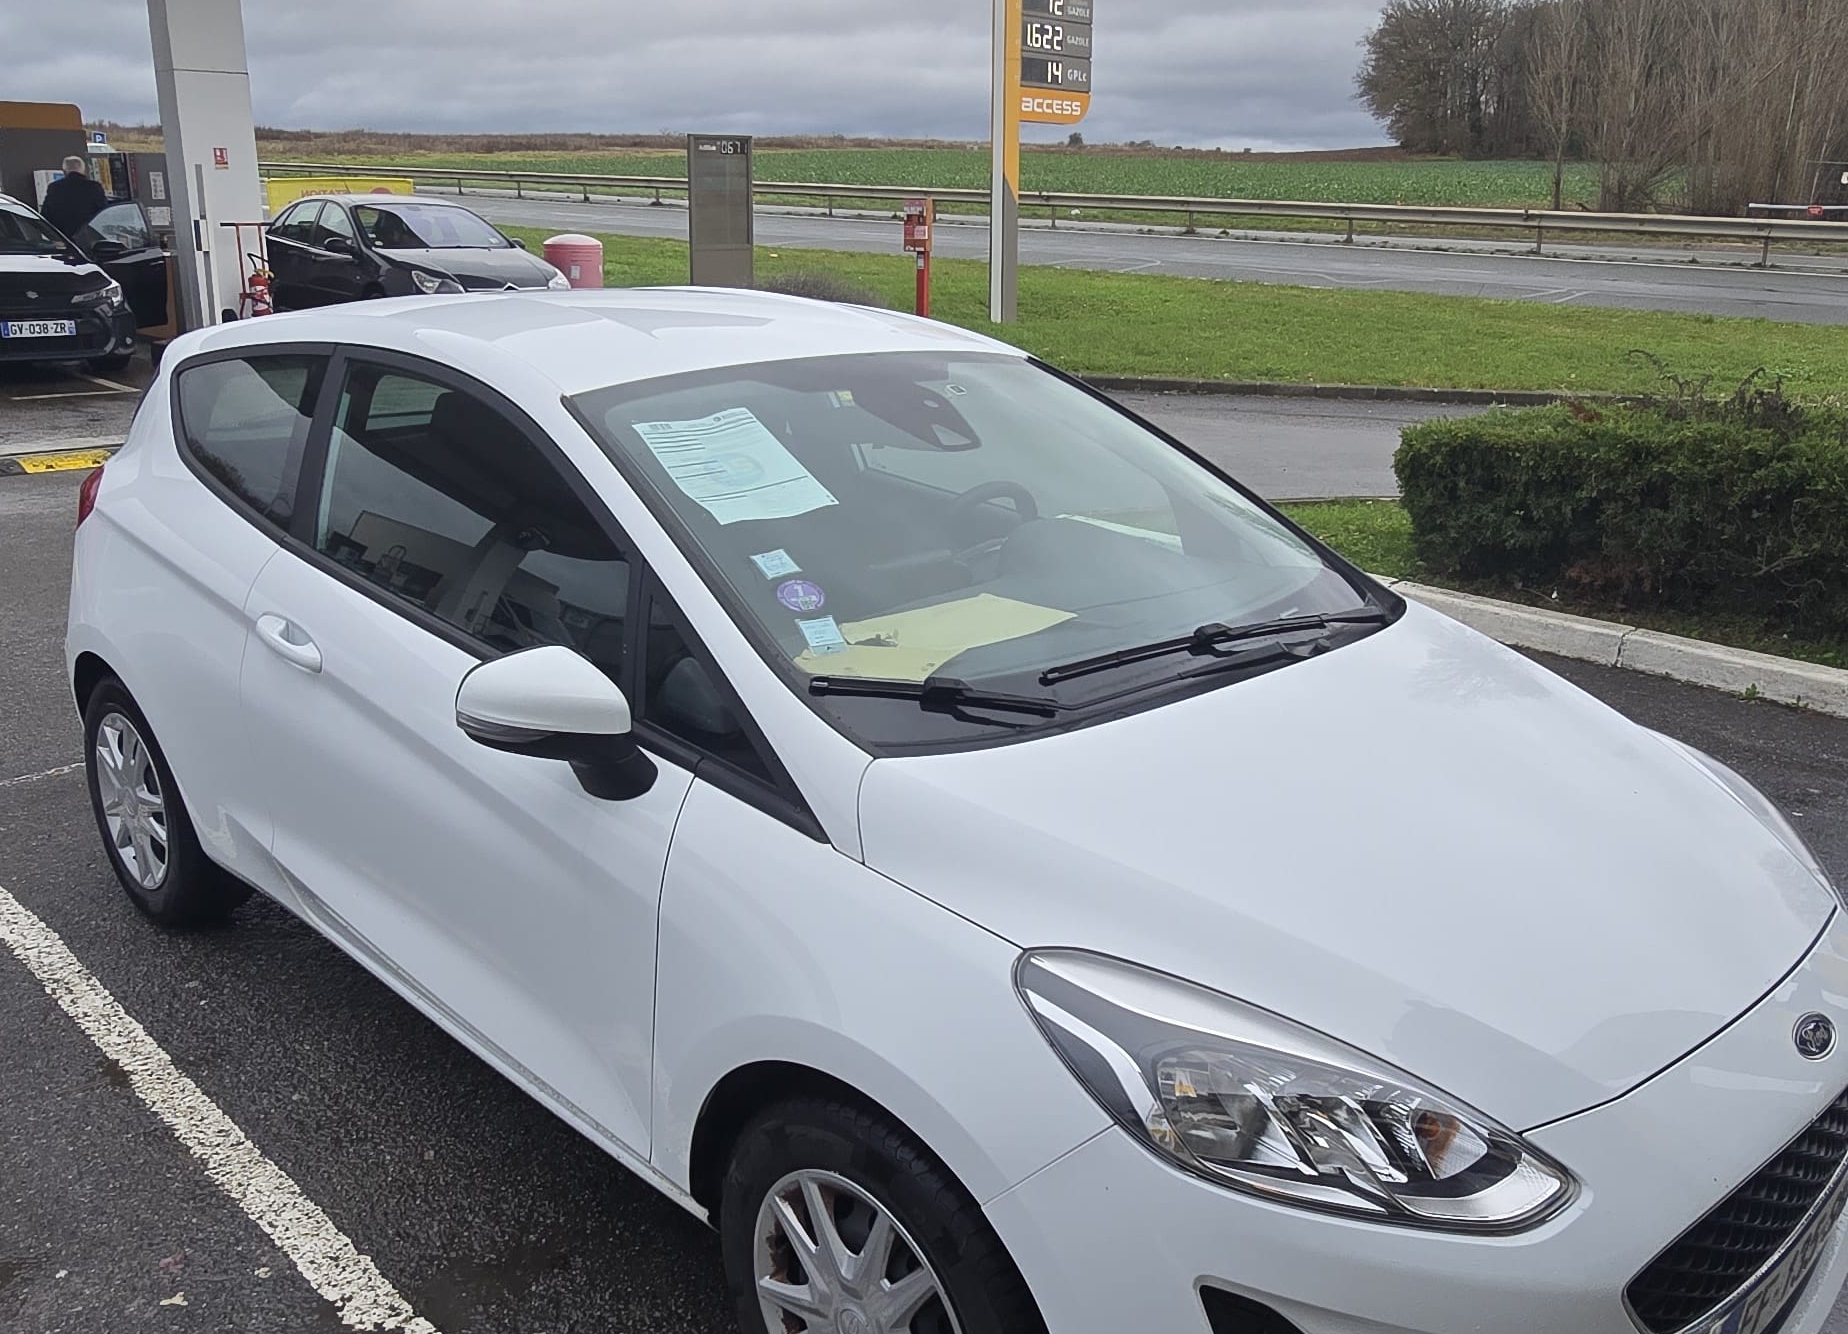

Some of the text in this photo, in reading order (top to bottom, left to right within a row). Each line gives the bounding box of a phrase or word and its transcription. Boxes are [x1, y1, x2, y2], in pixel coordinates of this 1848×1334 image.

[1067, 5, 1090, 18] GAZOLE
[1066, 34, 1089, 47] GAZOLE
[1047, 61, 1062, 84] 14
[10, 322, 67, 336] GV-038-ZR
